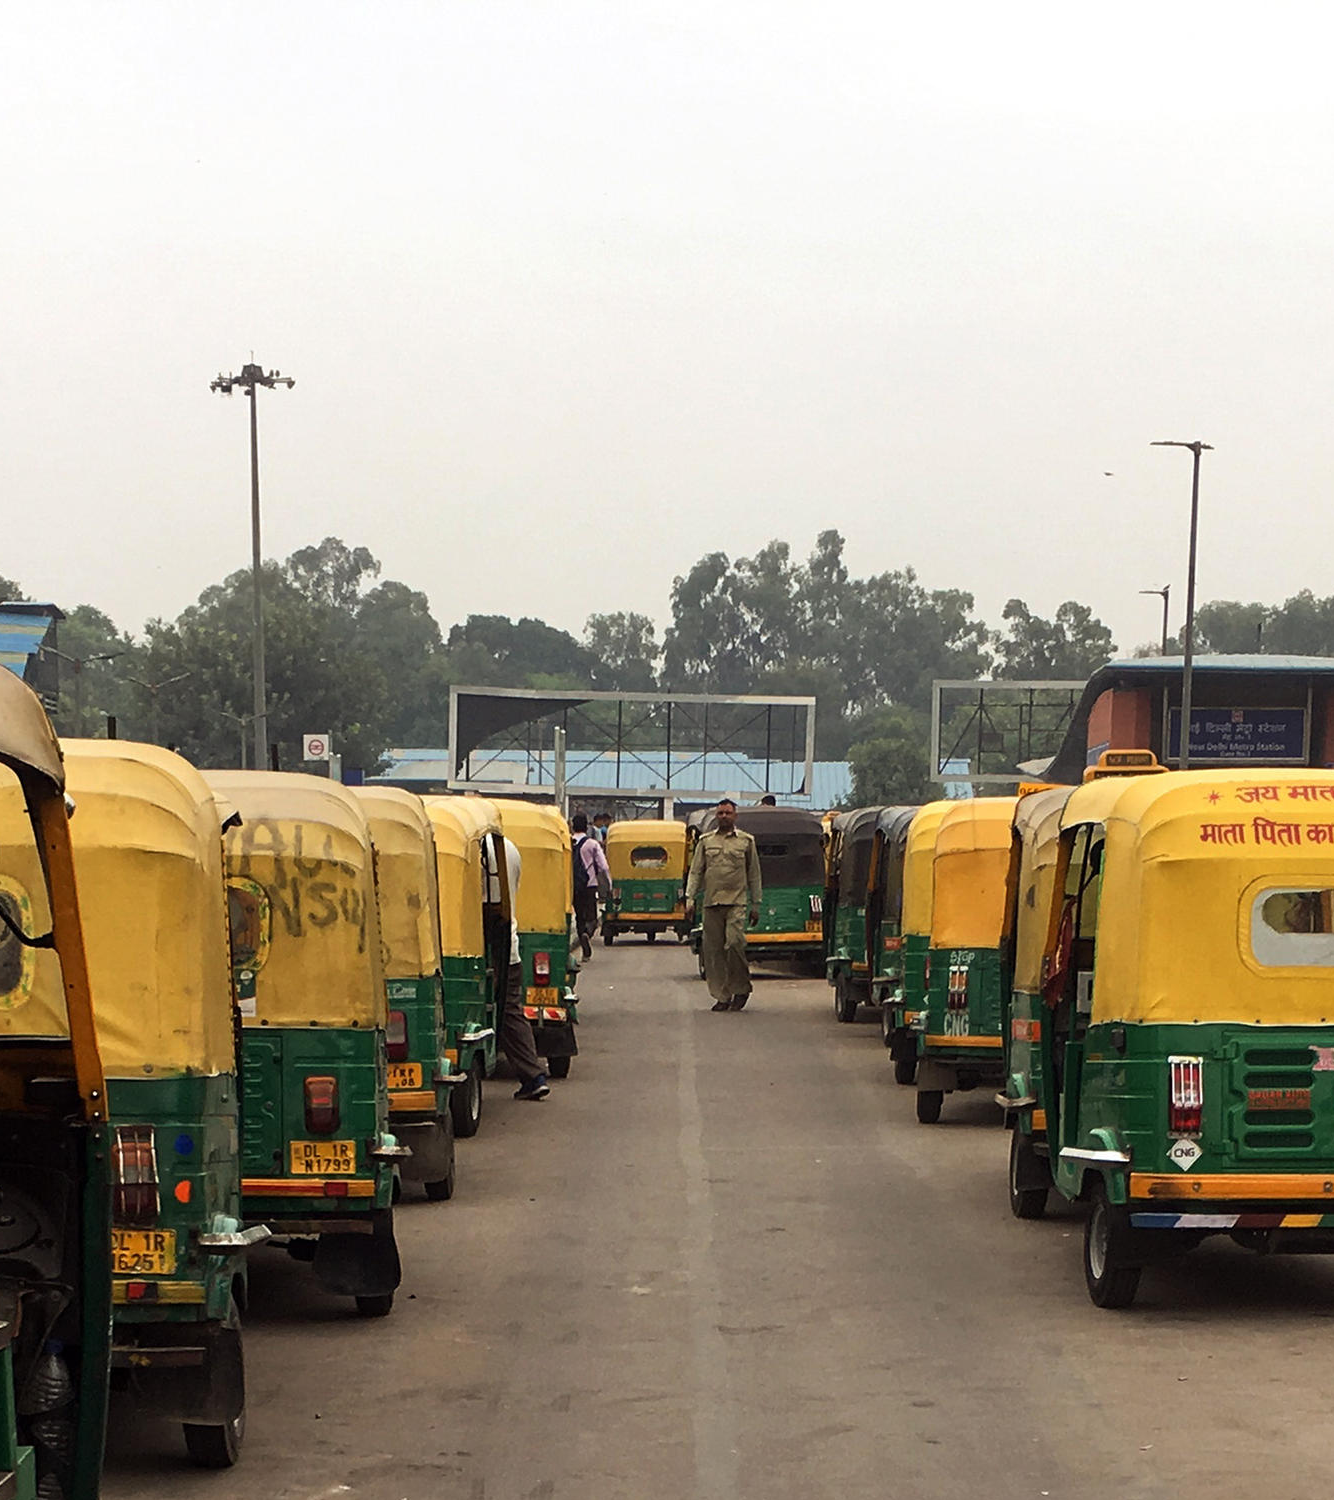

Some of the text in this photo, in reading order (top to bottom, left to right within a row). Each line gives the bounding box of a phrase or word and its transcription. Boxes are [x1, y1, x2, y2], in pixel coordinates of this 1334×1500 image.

[1207, 742, 1228, 751] Delhi
[1229, 742, 1255, 751] Metro
[1257, 742, 1286, 751] Station
[1235, 785, 1280, 803] जय
[1200, 823, 1246, 847] माता
[1253, 816, 1302, 847] पिता
[1306, 823, 1334, 845] का
[943, 1013, 970, 1036] CNG
[303, 1144, 349, 1158] DL 1R
[1173, 1149, 1196, 1158] CNG
[143, 1233, 166, 1252] 1R
